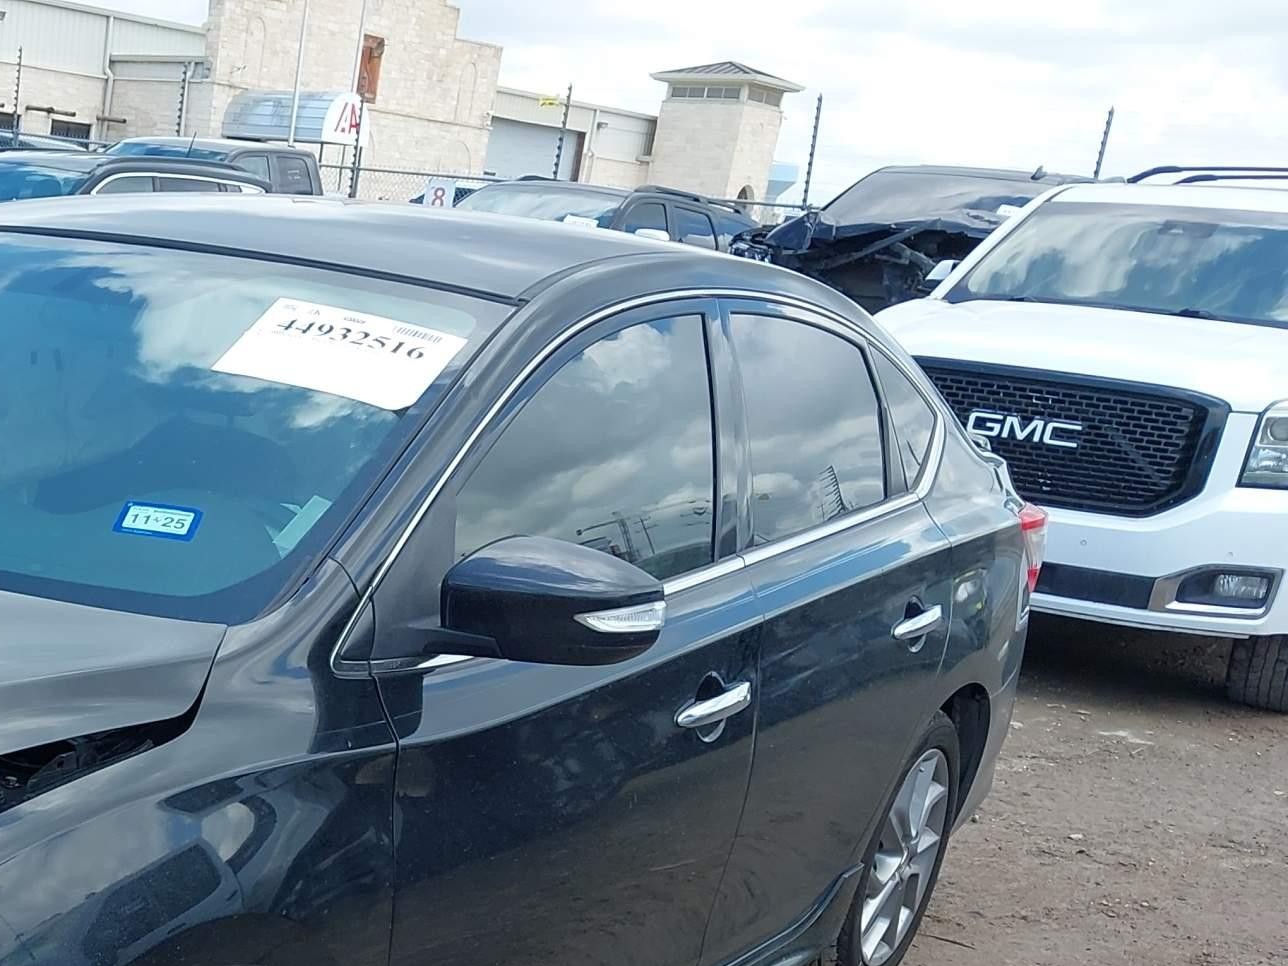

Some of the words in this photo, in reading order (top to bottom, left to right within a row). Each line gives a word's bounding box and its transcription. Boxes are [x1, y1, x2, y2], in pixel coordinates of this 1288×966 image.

[431, 187, 445, 206] 8
[277, 317, 425, 361] 44932516
[966, 411, 1083, 448] GMC
[130, 513, 151, 525] 11
[160, 516, 188, 530] 25
